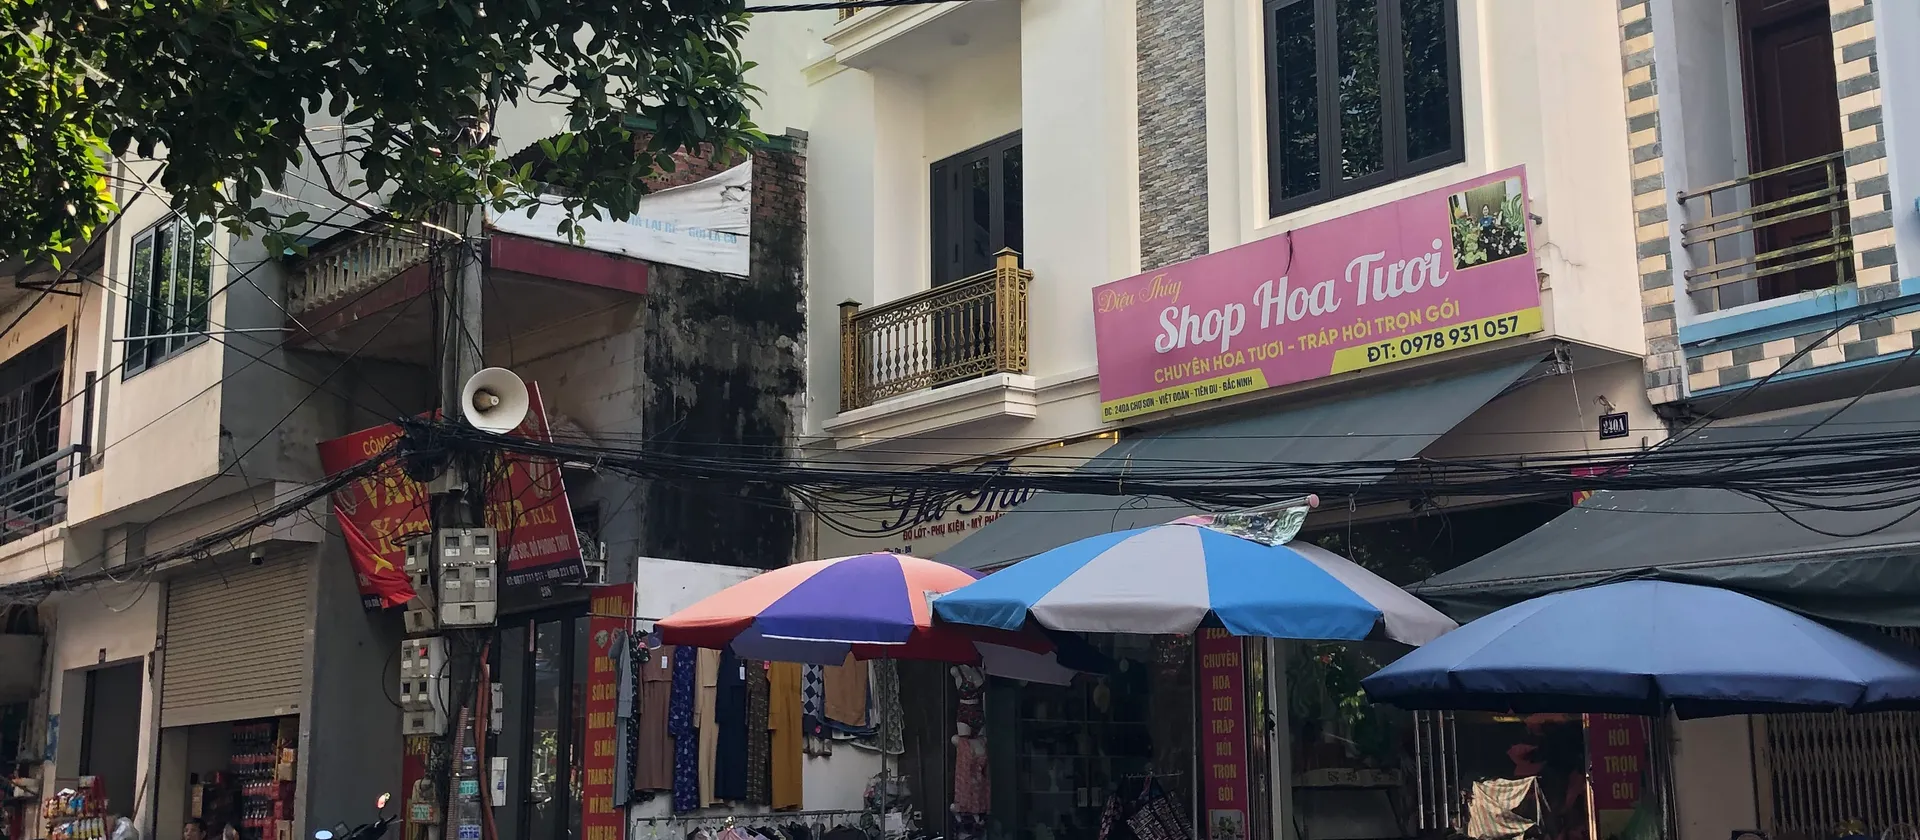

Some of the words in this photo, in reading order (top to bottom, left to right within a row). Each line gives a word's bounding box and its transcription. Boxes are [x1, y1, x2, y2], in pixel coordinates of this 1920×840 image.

[1098, 289, 1135, 312] Diệu
[1154, 302, 1246, 354] Shop
[1253, 273, 1342, 331] Hoa
[1345, 238, 1450, 307] Tươi
[1154, 357, 1210, 384] CHUYÊN
[1213, 349, 1246, 371] HOA
[1247, 340, 1284, 363] TƯƠI
[1298, 327, 1339, 351] TRÁP
[1342, 318, 1372, 342] HỎI
[1375, 311, 1422, 334] TRỌN
[1425, 297, 1460, 322] GÓI
[1367, 343, 1397, 363] ĐT:
[1400, 331, 1445, 356] 0978
[1448, 323, 1479, 344] 931
[1483, 315, 1519, 338] 057
[1115, 402, 1130, 415] 240A
[1209, 383, 1219, 394] DU
[1236, 376, 1253, 388] NINH
[1603, 417, 1624, 434] 240A
[947, 520, 965, 535] KIỆN
[1203, 650, 1239, 668] CHUYÊN
[1212, 675, 1231, 690] HOA
[1212, 696, 1233, 712] TƯƠI
[1212, 716, 1235, 734] TRÁP
[1603, 755, 1638, 776] TRỌN
[1218, 784, 1234, 801] GÓI
[1612, 778, 1634, 799] GÓI
